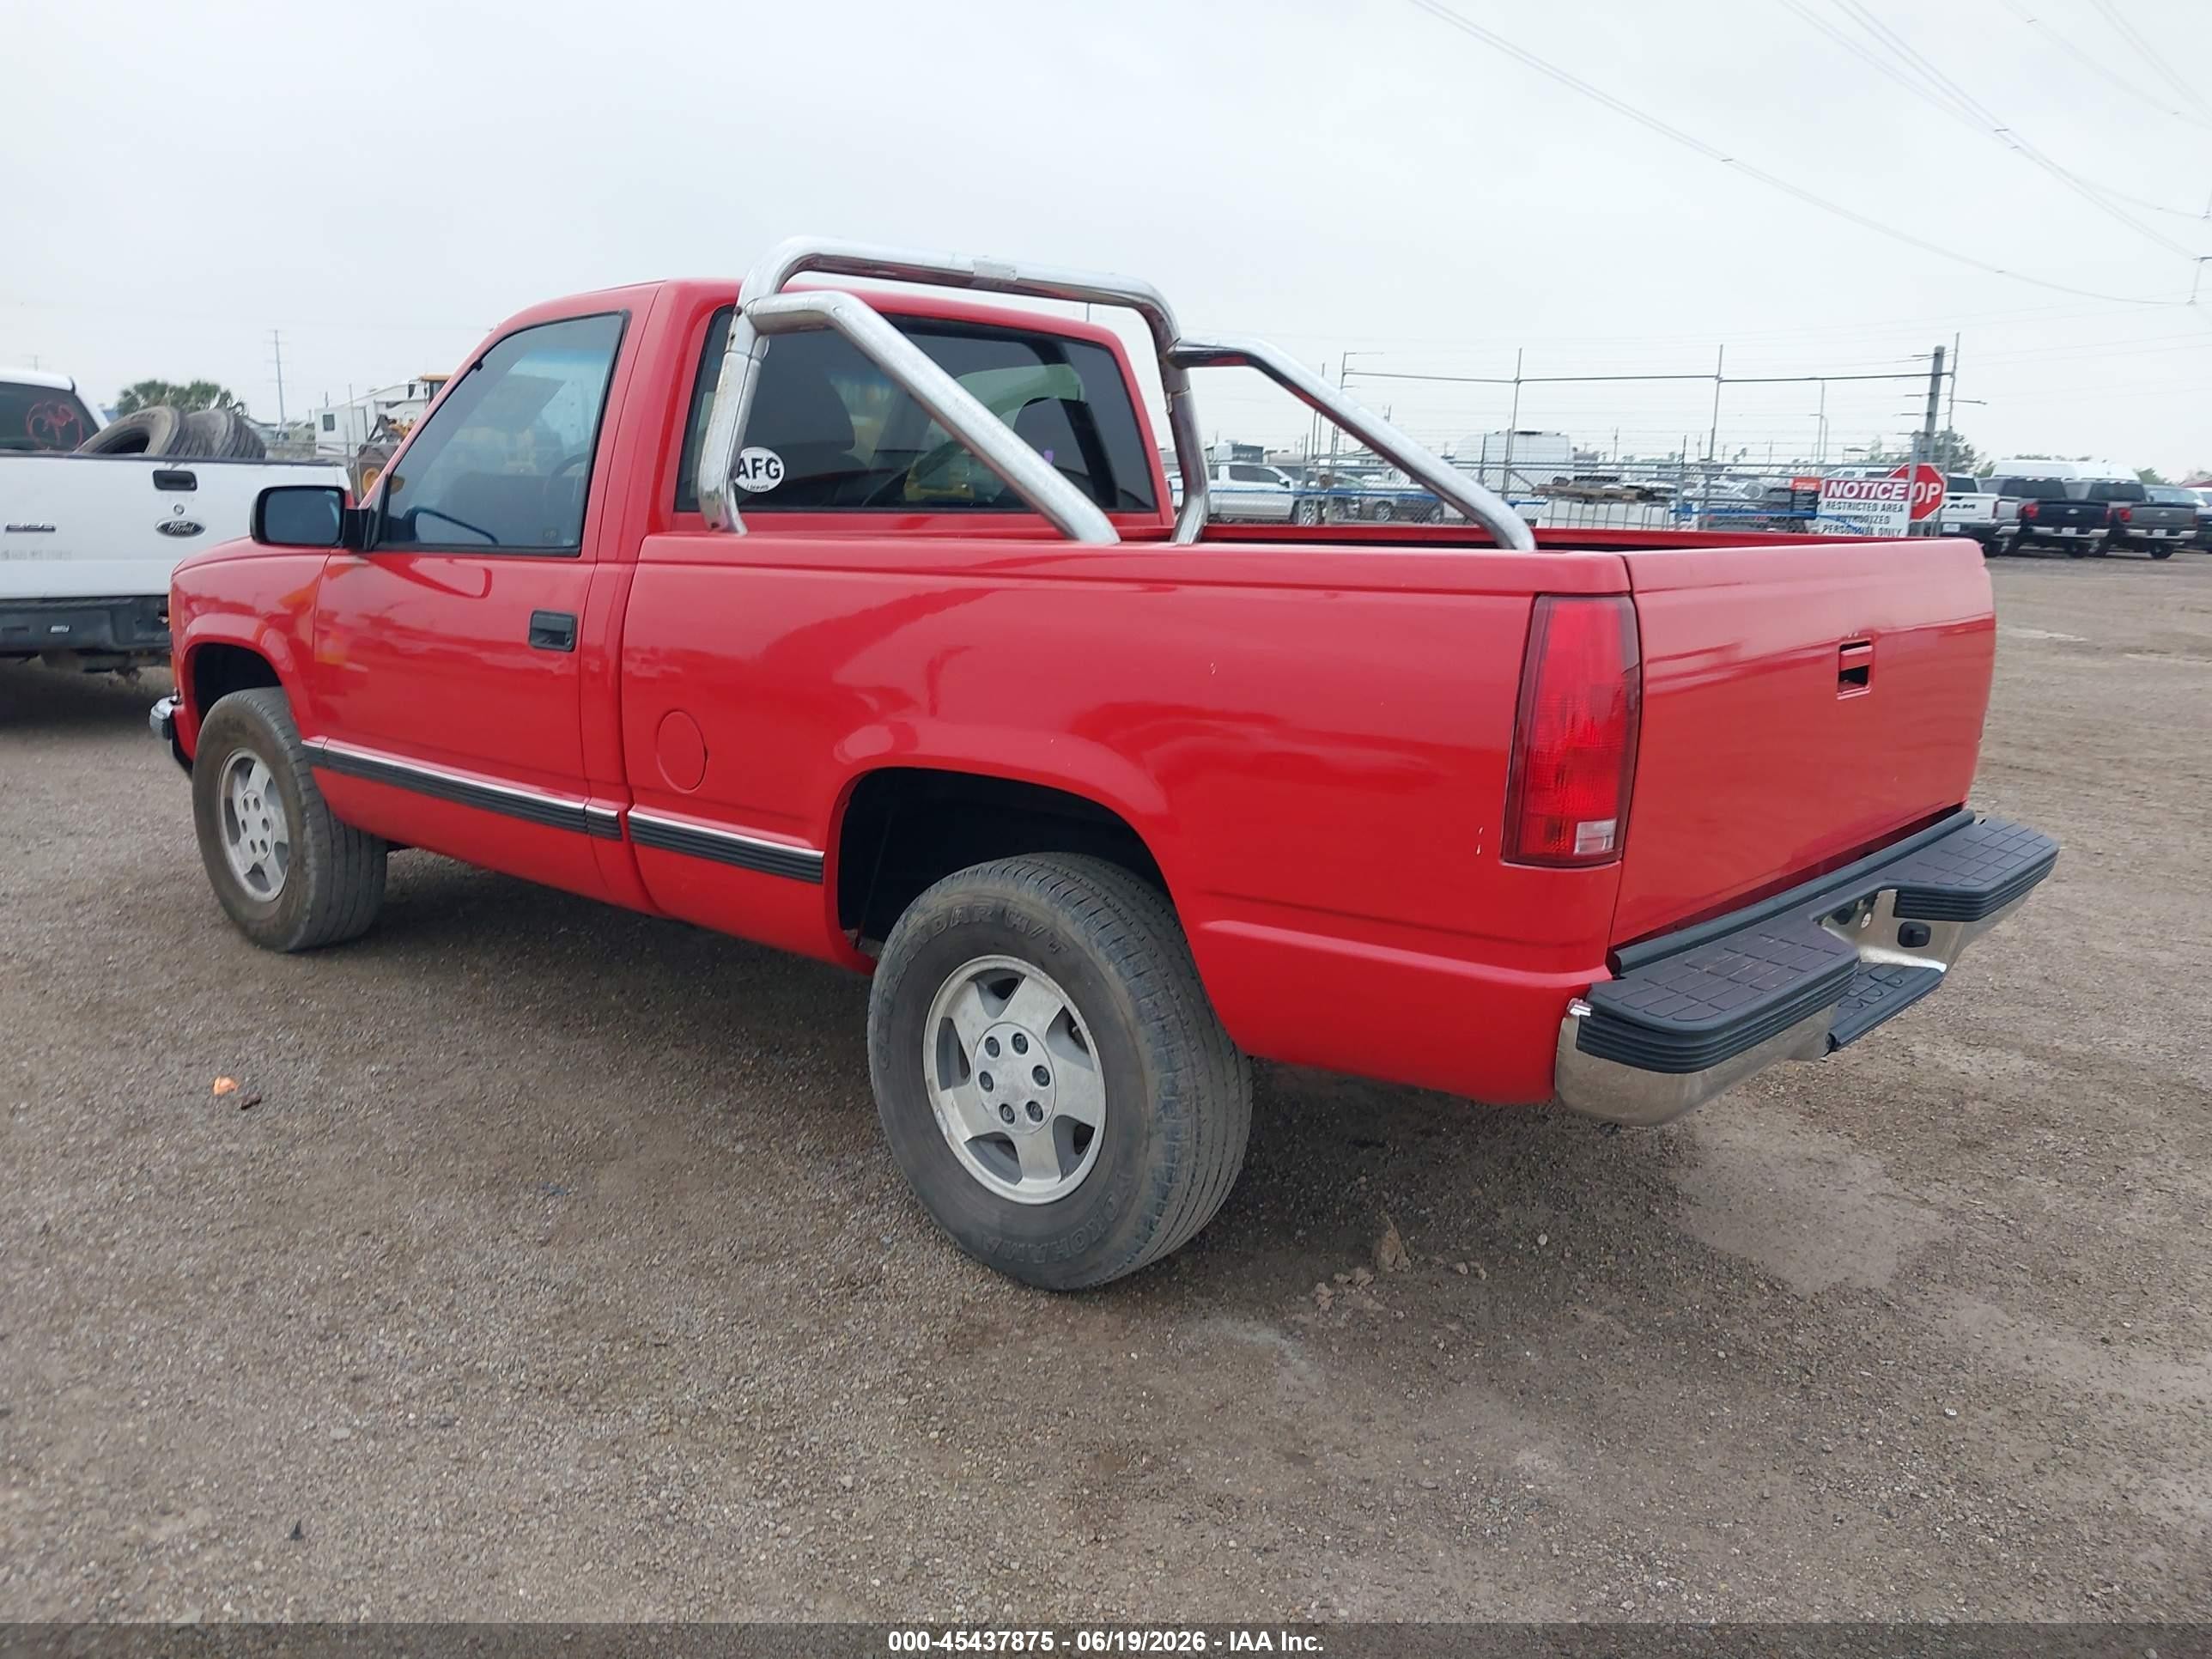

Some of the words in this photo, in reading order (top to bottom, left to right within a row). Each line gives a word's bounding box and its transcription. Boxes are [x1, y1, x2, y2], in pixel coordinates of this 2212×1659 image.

[737, 457, 781, 479] AFG
[1827, 481, 1907, 500] NOTICE
[1913, 482, 1942, 504] OP
[1826, 501, 1877, 512] RESTRICTED
[1881, 503, 1903, 513] AREA
[1878, 526, 1902, 538] ONLY
